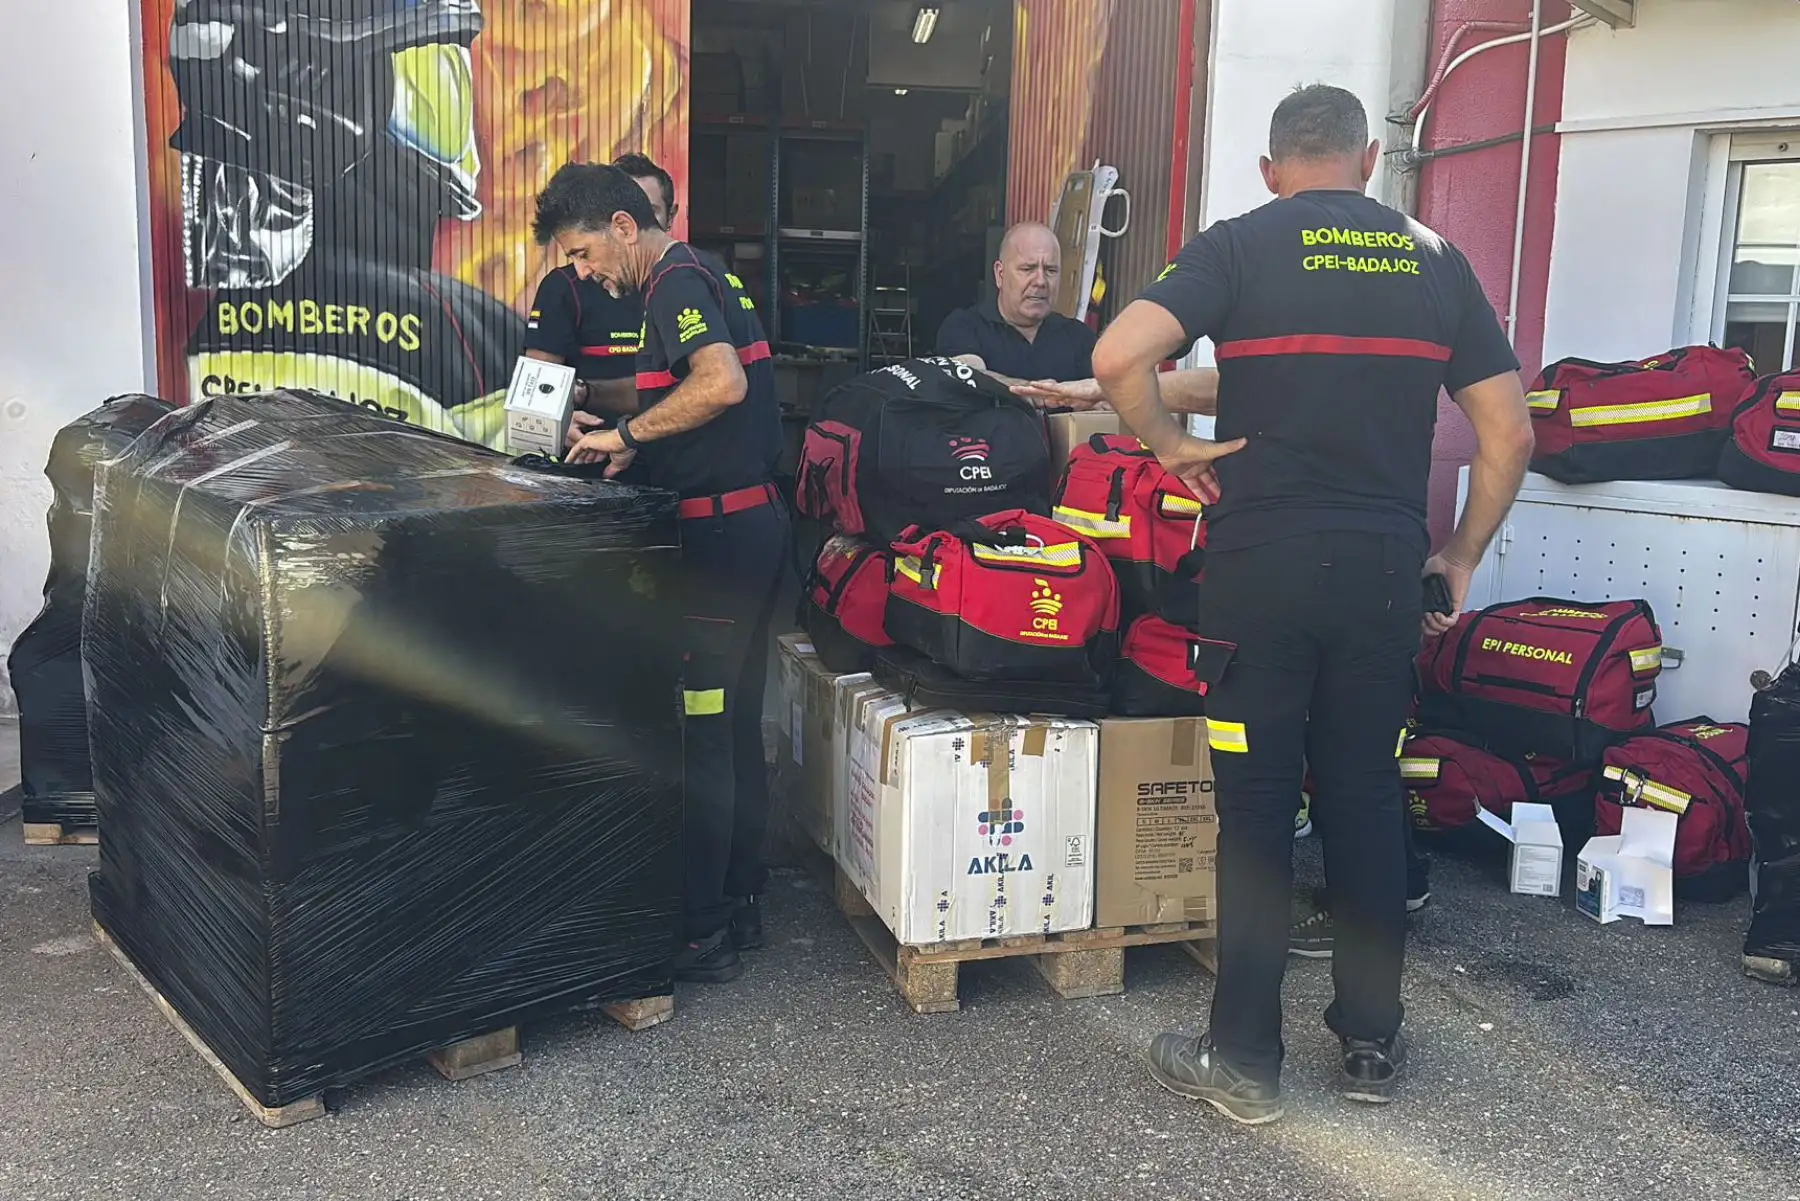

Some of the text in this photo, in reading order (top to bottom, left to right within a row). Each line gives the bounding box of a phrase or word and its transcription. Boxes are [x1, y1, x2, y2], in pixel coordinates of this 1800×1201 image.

[1301, 227, 1415, 251] BOMBEROS
[1302, 254, 1420, 274] CPEI-BADAJOZ
[218, 298, 421, 351] BOMBEROS
[960, 466, 992, 480] CPEI
[1032, 617, 1058, 631] CPEI
[1482, 637, 1573, 665] EPI PERSONAL
[1137, 780, 1213, 796] SAFETO
[967, 853, 1034, 875] AKILA
